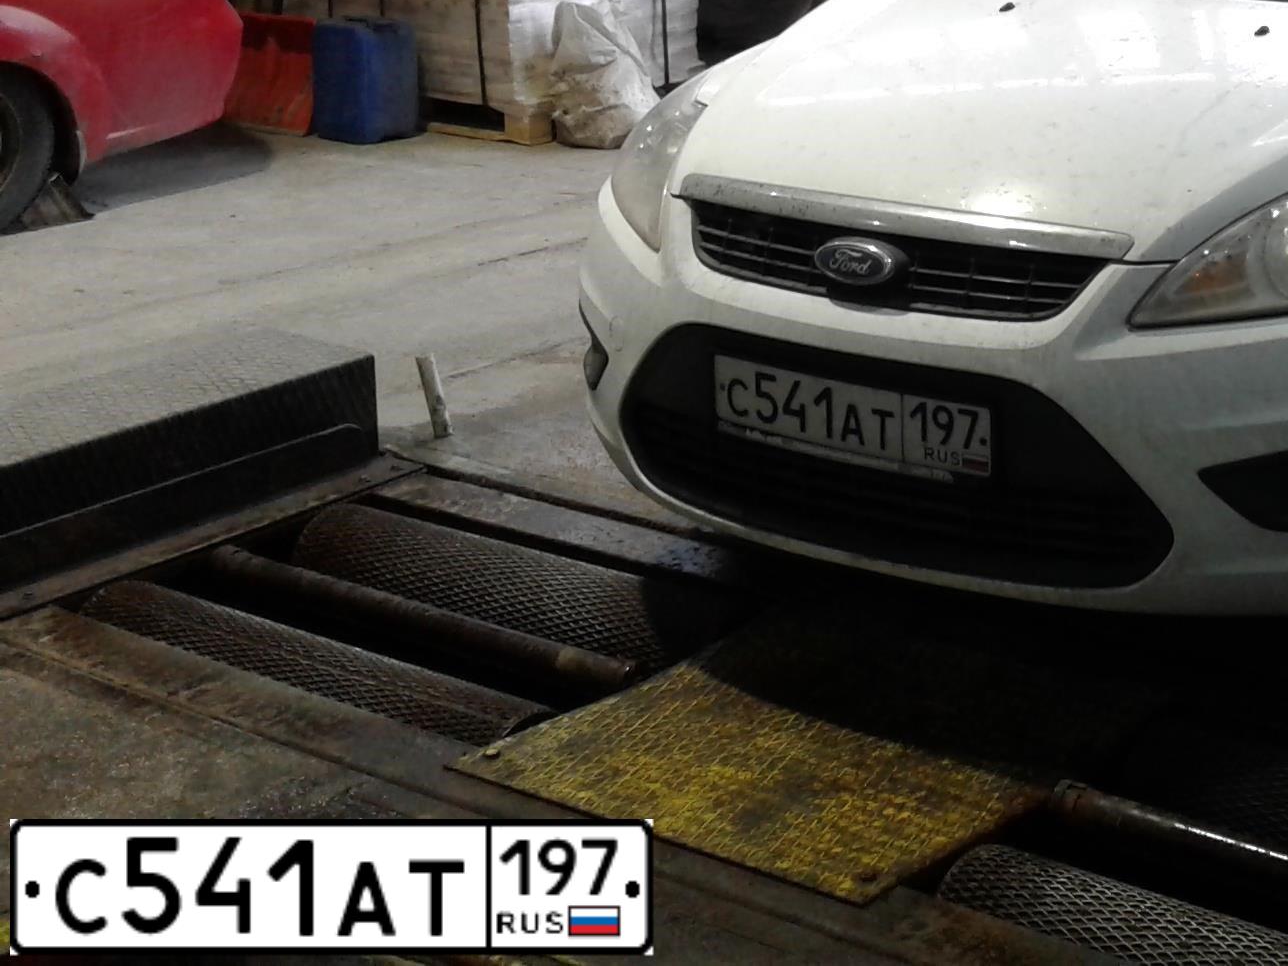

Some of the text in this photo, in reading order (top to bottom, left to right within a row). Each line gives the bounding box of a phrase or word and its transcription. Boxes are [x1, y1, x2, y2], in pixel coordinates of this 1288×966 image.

[829, 248, 873, 275] Ford
[910, 401, 979, 450] 197
[923, 447, 962, 466] RUS
